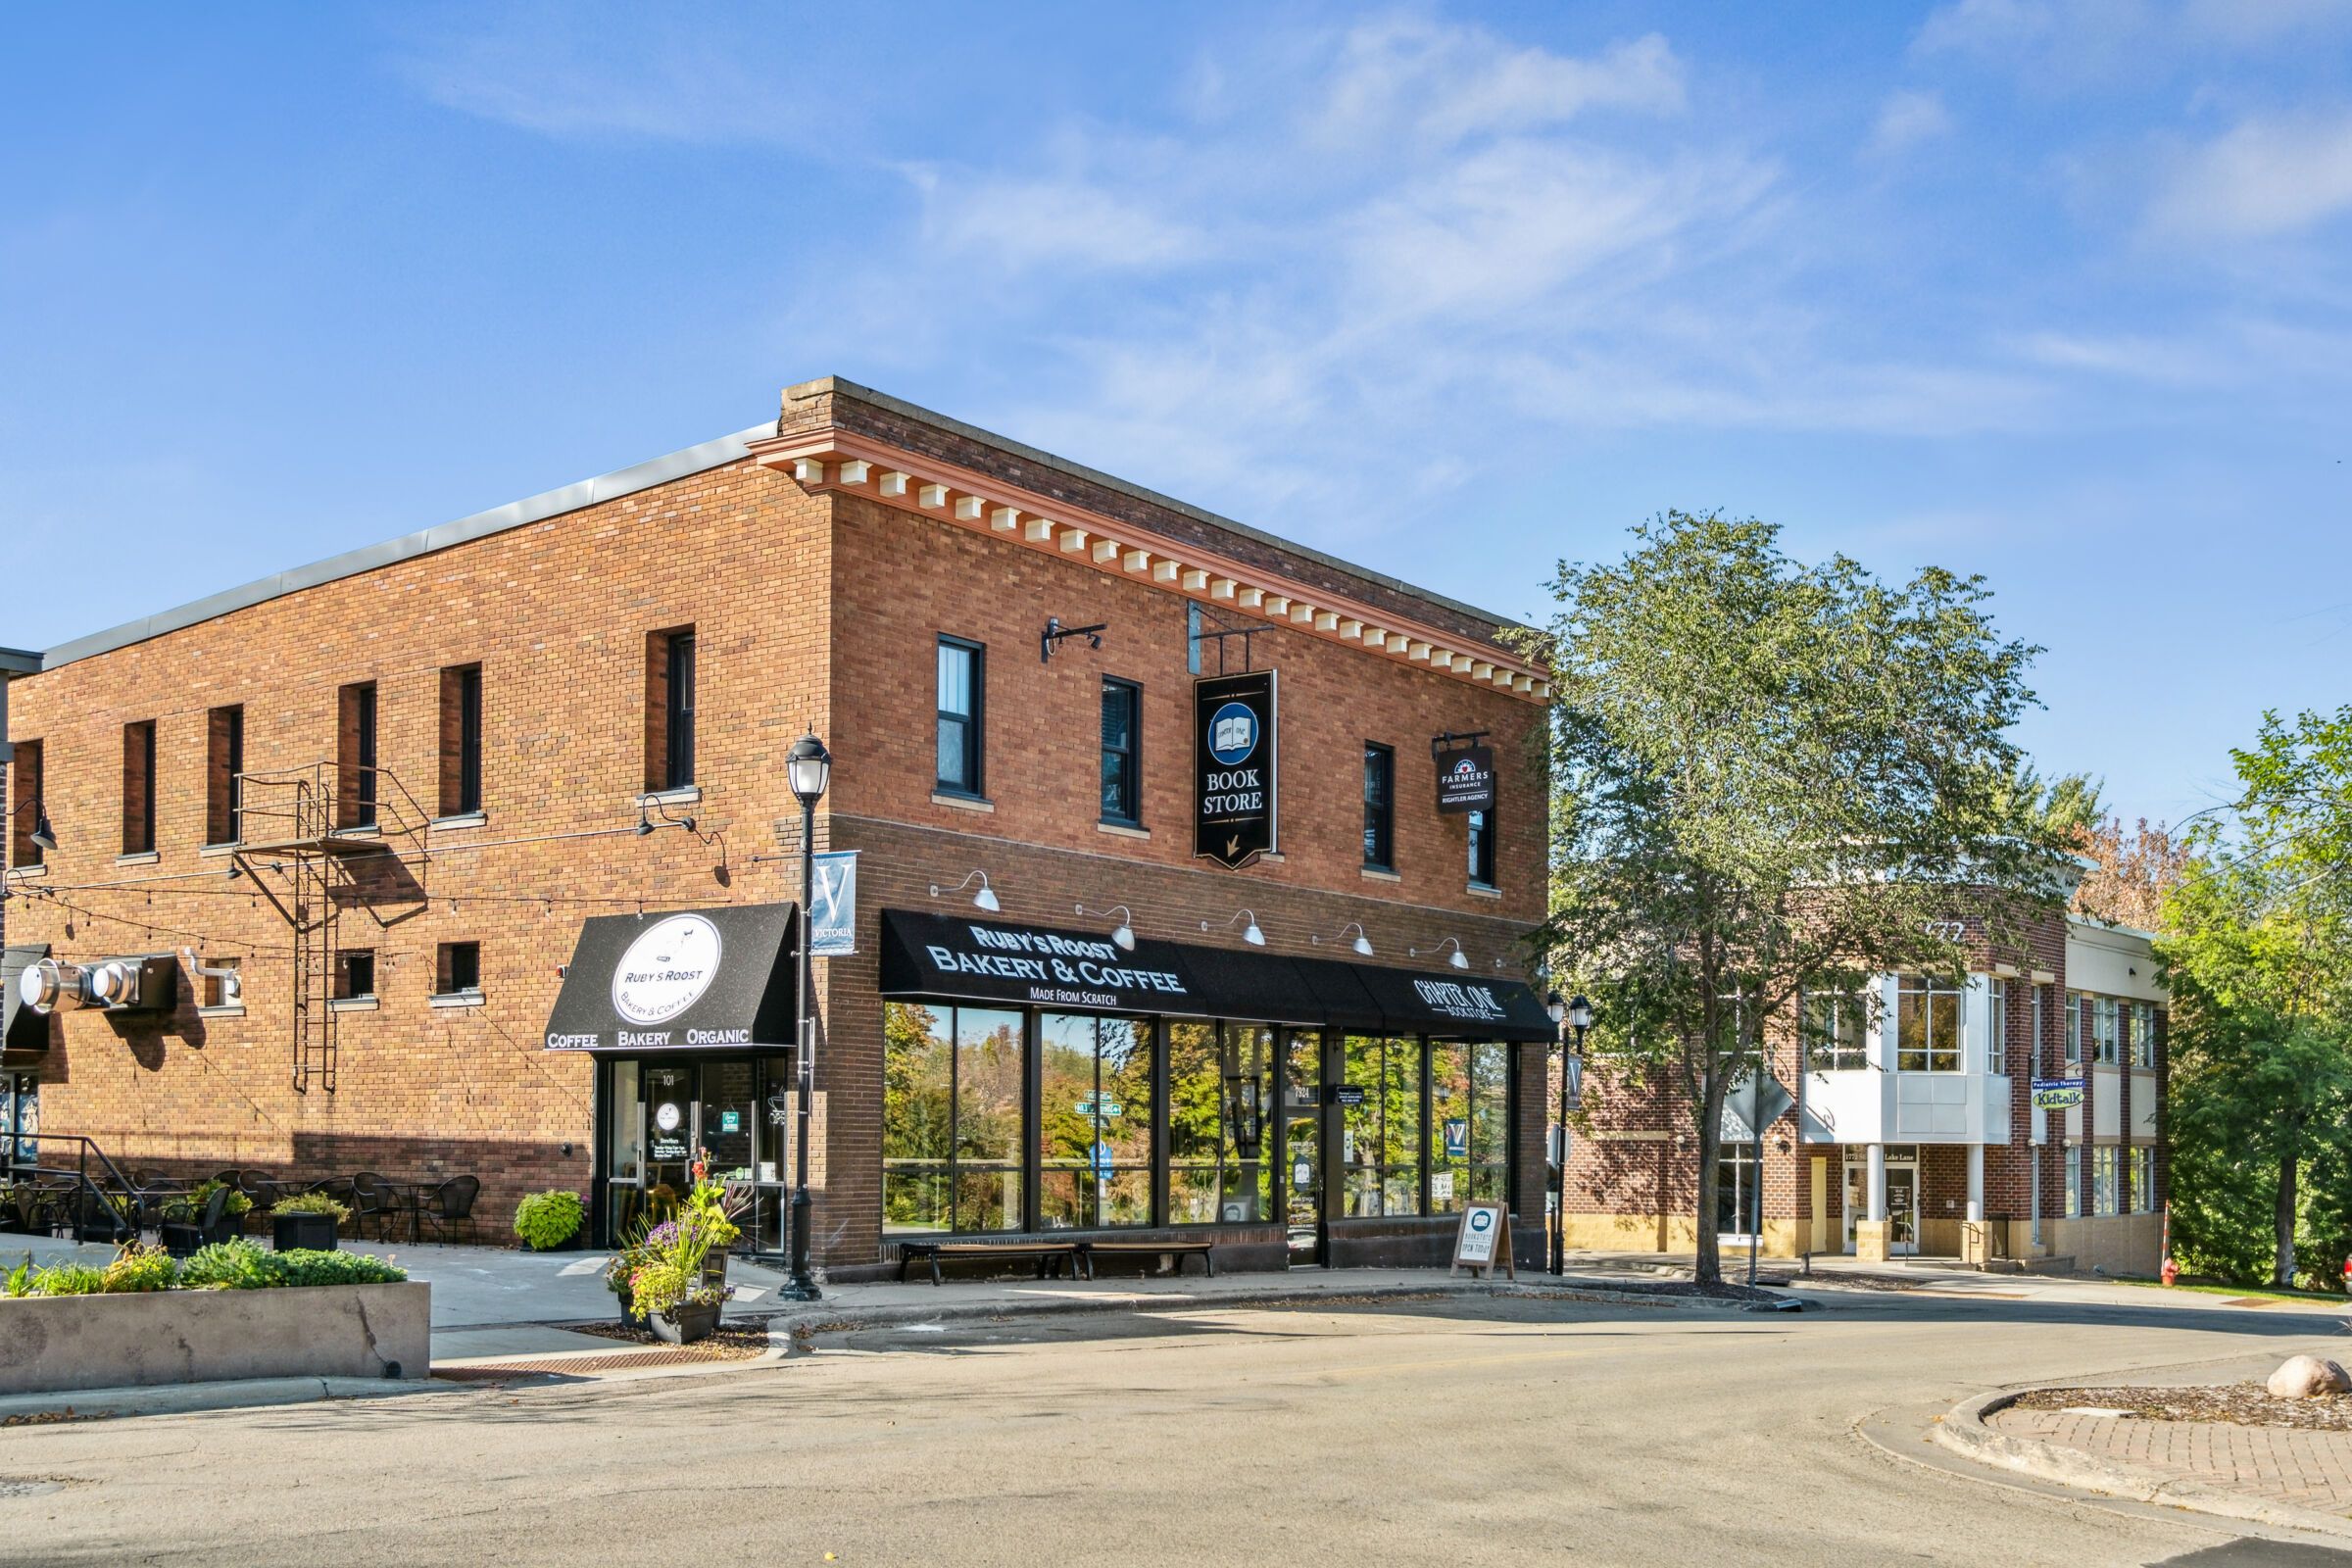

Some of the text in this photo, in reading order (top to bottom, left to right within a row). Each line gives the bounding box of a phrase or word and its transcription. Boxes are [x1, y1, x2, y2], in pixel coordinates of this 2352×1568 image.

[1206, 768, 1260, 792] BOOK
[1442, 771, 1489, 784] FARMERS
[1449, 781, 1481, 790] INSURANCE
[1203, 792, 1262, 814] STORE
[816, 863, 853, 922] V
[815, 928, 852, 937] VICTORIA
[969, 925, 1117, 961] RUBY'S ROOST
[664, 970, 703, 982] ROOST
[926, 945, 1188, 995] BAKERY & COFFEE
[620, 991, 647, 1015] BAKERY
[647, 1006, 656, 1016] &
[1030, 987, 1117, 1006] MADE FROM SCRATCH
[1413, 980, 1502, 1010] CHAPTER ONE
[1446, 1004, 1494, 1019] BOOKSTORE
[547, 1029, 750, 1049] COFFEE BAKERY ORGANIC
[662, 1074, 674, 1086] 101
[1294, 1085, 1309, 1099] 7924
[2037, 1092, 2081, 1105] Kidtalk
